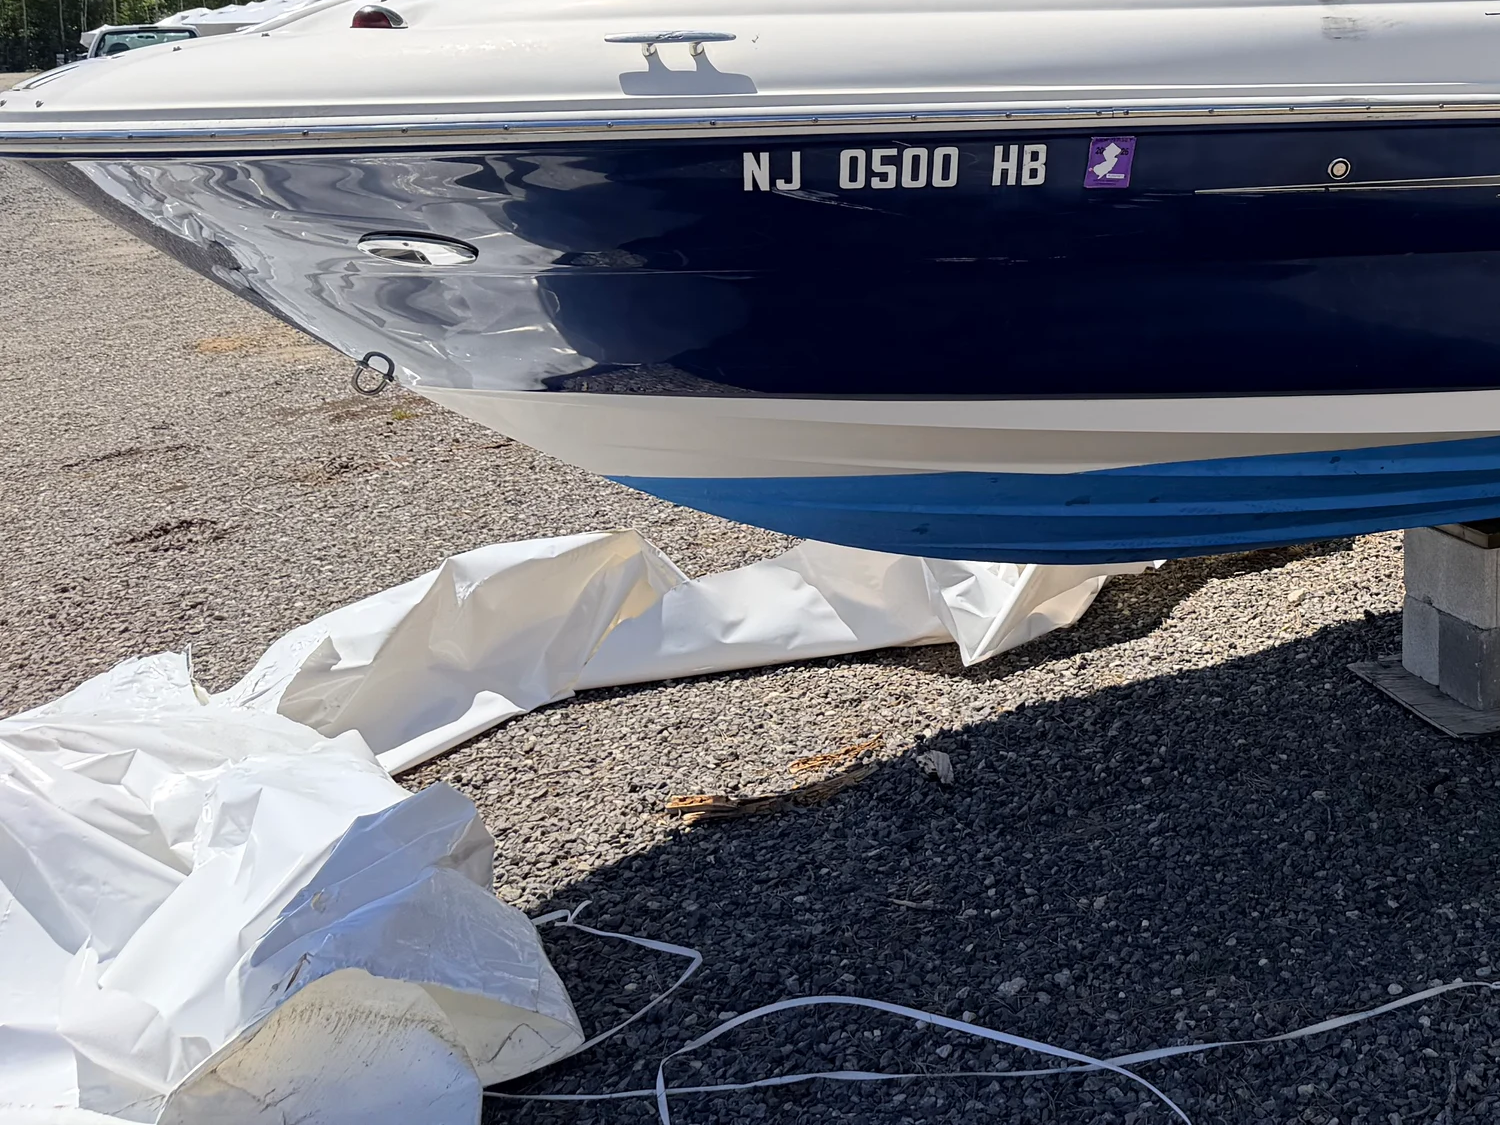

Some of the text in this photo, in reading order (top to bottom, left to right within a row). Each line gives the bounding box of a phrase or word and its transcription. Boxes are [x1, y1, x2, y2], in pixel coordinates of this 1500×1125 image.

[743, 144, 1047, 191] NJ 0500 HB
